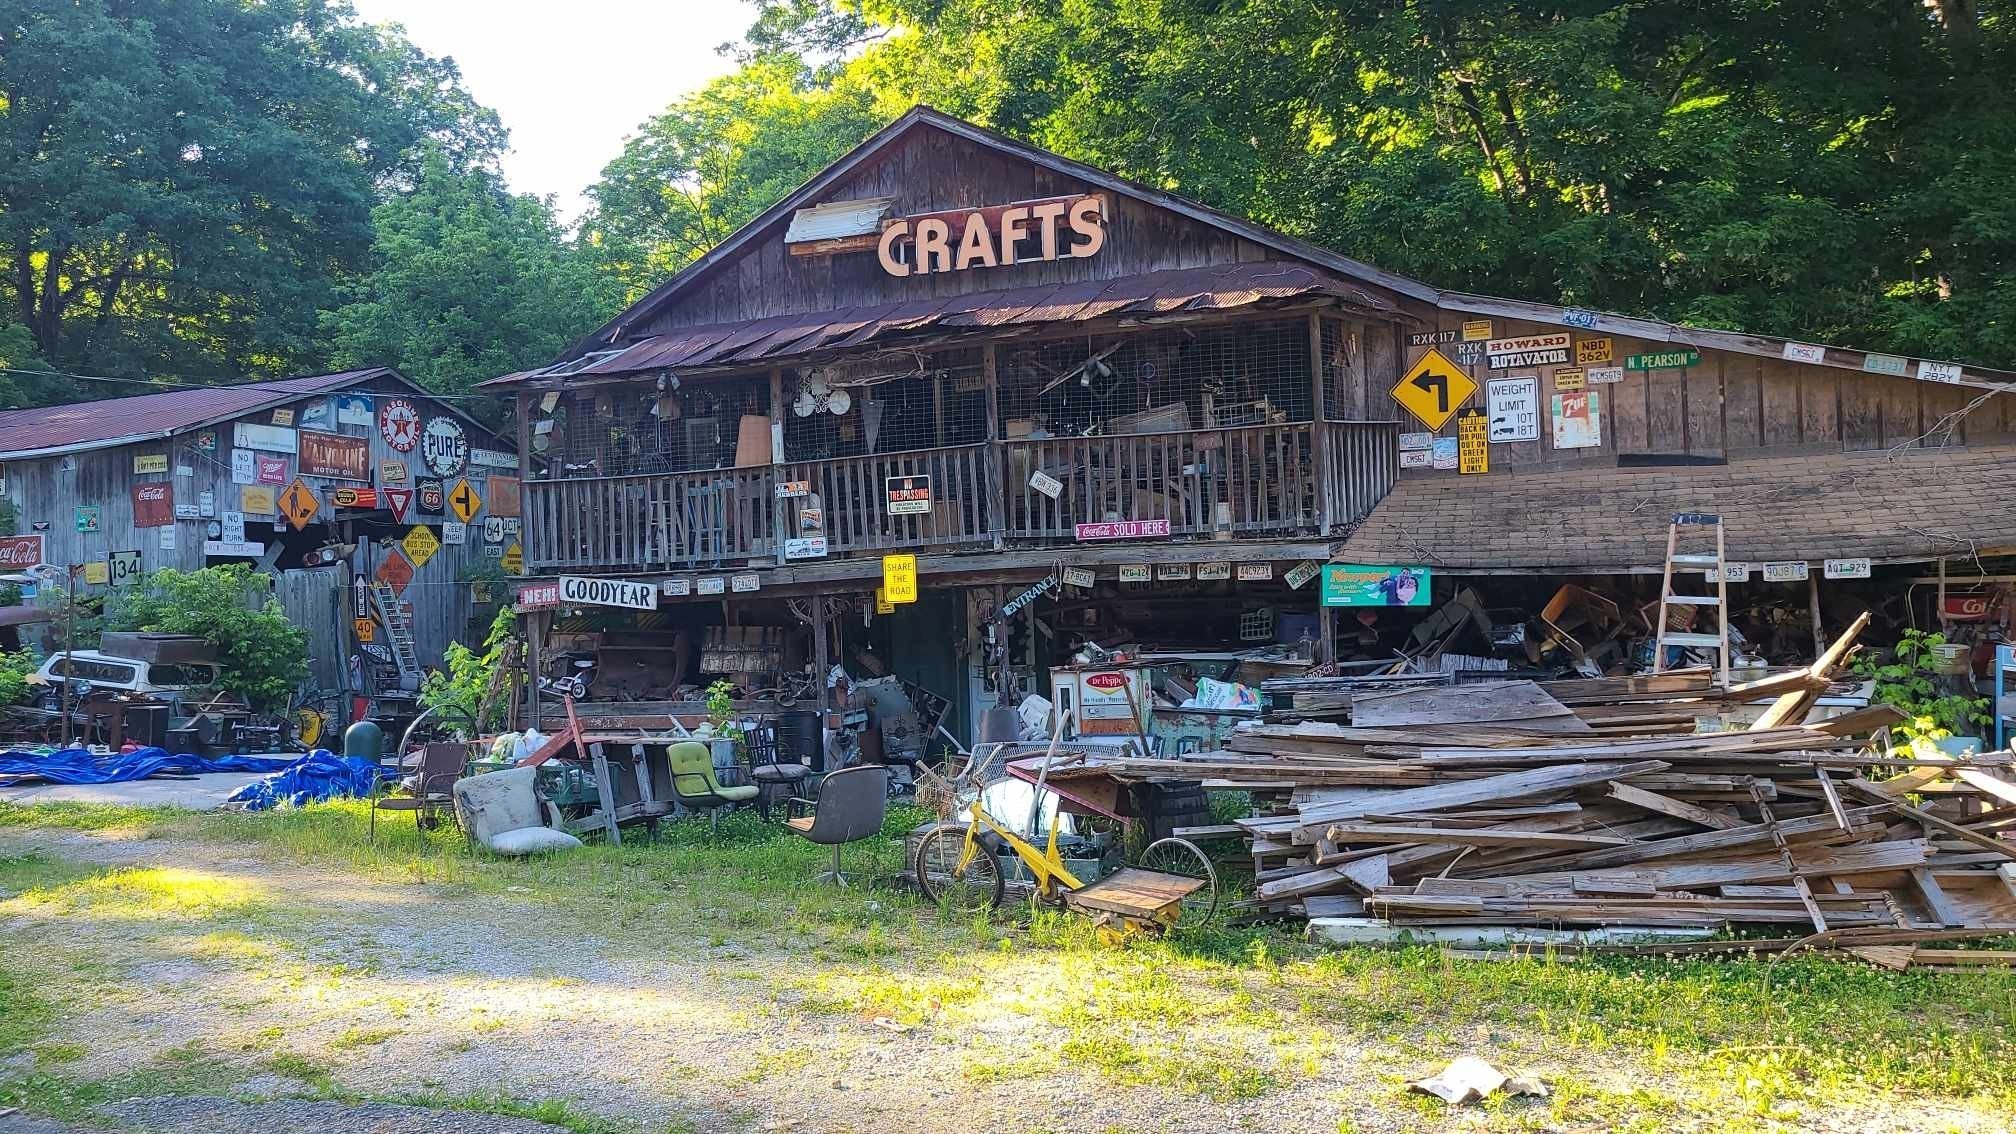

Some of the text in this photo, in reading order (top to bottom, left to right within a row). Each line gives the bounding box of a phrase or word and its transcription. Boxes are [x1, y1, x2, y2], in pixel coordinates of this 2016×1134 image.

[878, 198, 1104, 276] CRAFTS
[1413, 332, 1456, 345] RXK 117
[1490, 336, 1567, 350] HOWARD
[1458, 342, 1483, 353] RXK
[1582, 340, 1606, 351] NBD
[1490, 350, 1568, 369] ROTAVATOR
[1578, 350, 1611, 361] 362V
[1641, 354, 1688, 367] PEARSON
[1491, 383, 1533, 396] WEIGHT
[382, 400, 420, 421] GASOLINE
[1498, 401, 1525, 411] LIMIT
[1458, 417, 1488, 425] CAUTION
[1516, 413, 1533, 424] 10T
[1517, 425, 1534, 435] 18T
[382, 426, 421, 451] MOTOR OIL
[1477, 440, 1486, 448] ON
[428, 434, 464, 458] PURE
[238, 454, 249, 462] NO
[312, 466, 340, 475] MOTOR
[903, 478, 913, 490] NO
[138, 488, 164, 501] Coca-Cola
[425, 494, 439, 503] 66
[889, 488, 929, 501] TRESPASSING
[227, 514, 239, 523] NO
[224, 525, 242, 533] RIGHT
[486, 521, 501, 537] 64
[1082, 521, 1164, 537] Coca-Cola SOLD HERE
[410, 533, 431, 541] SCHOOL
[419, 541, 435, 549] STOP
[0, 541, 38, 564] ca-Cola
[486, 547, 501, 556] EAST
[112, 560, 138, 579] 134
[887, 563, 913, 572] SHARE
[1727, 567, 1743, 577] 953
[892, 574, 908, 583] THE
[565, 579, 650, 607] GOODYEAR
[890, 586, 912, 595] ROAD
[1961, 599, 1986, 614] Col
[357, 621, 371, 633] 40
[1092, 676, 1121, 686] Dr Pepp
